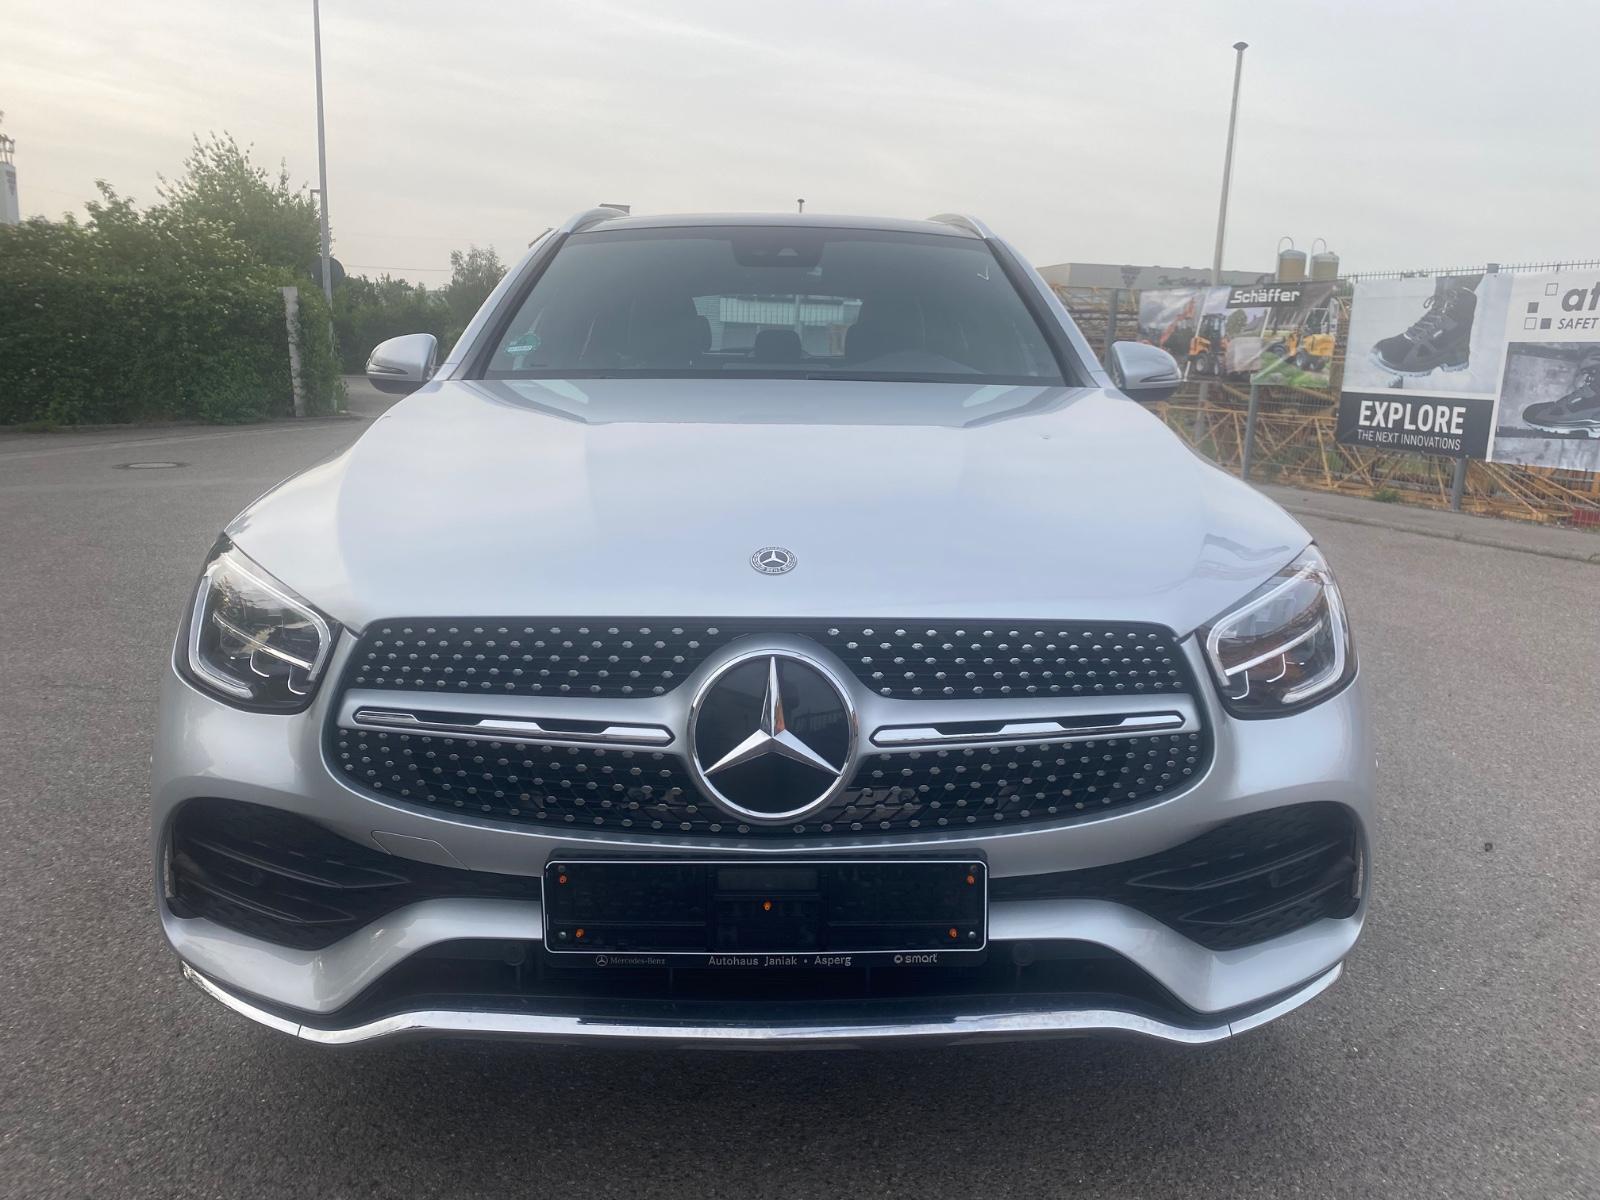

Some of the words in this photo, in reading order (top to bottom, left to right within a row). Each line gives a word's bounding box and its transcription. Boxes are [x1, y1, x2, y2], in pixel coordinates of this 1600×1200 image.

[1230, 288, 1300, 303] Schäffer
[1358, 400, 1467, 434] EXPLORE
[1358, 429, 1374, 441] THE
[1375, 431, 1399, 444] NEXT
[1401, 434, 1461, 451] INNOVATIONS
[610, 956, 666, 966] Mercedes-Benz
[708, 956, 759, 966] Autohaus
[764, 956, 798, 967] Janiak
[814, 955, 852, 967] Asperg
[905, 953, 938, 964] smart
